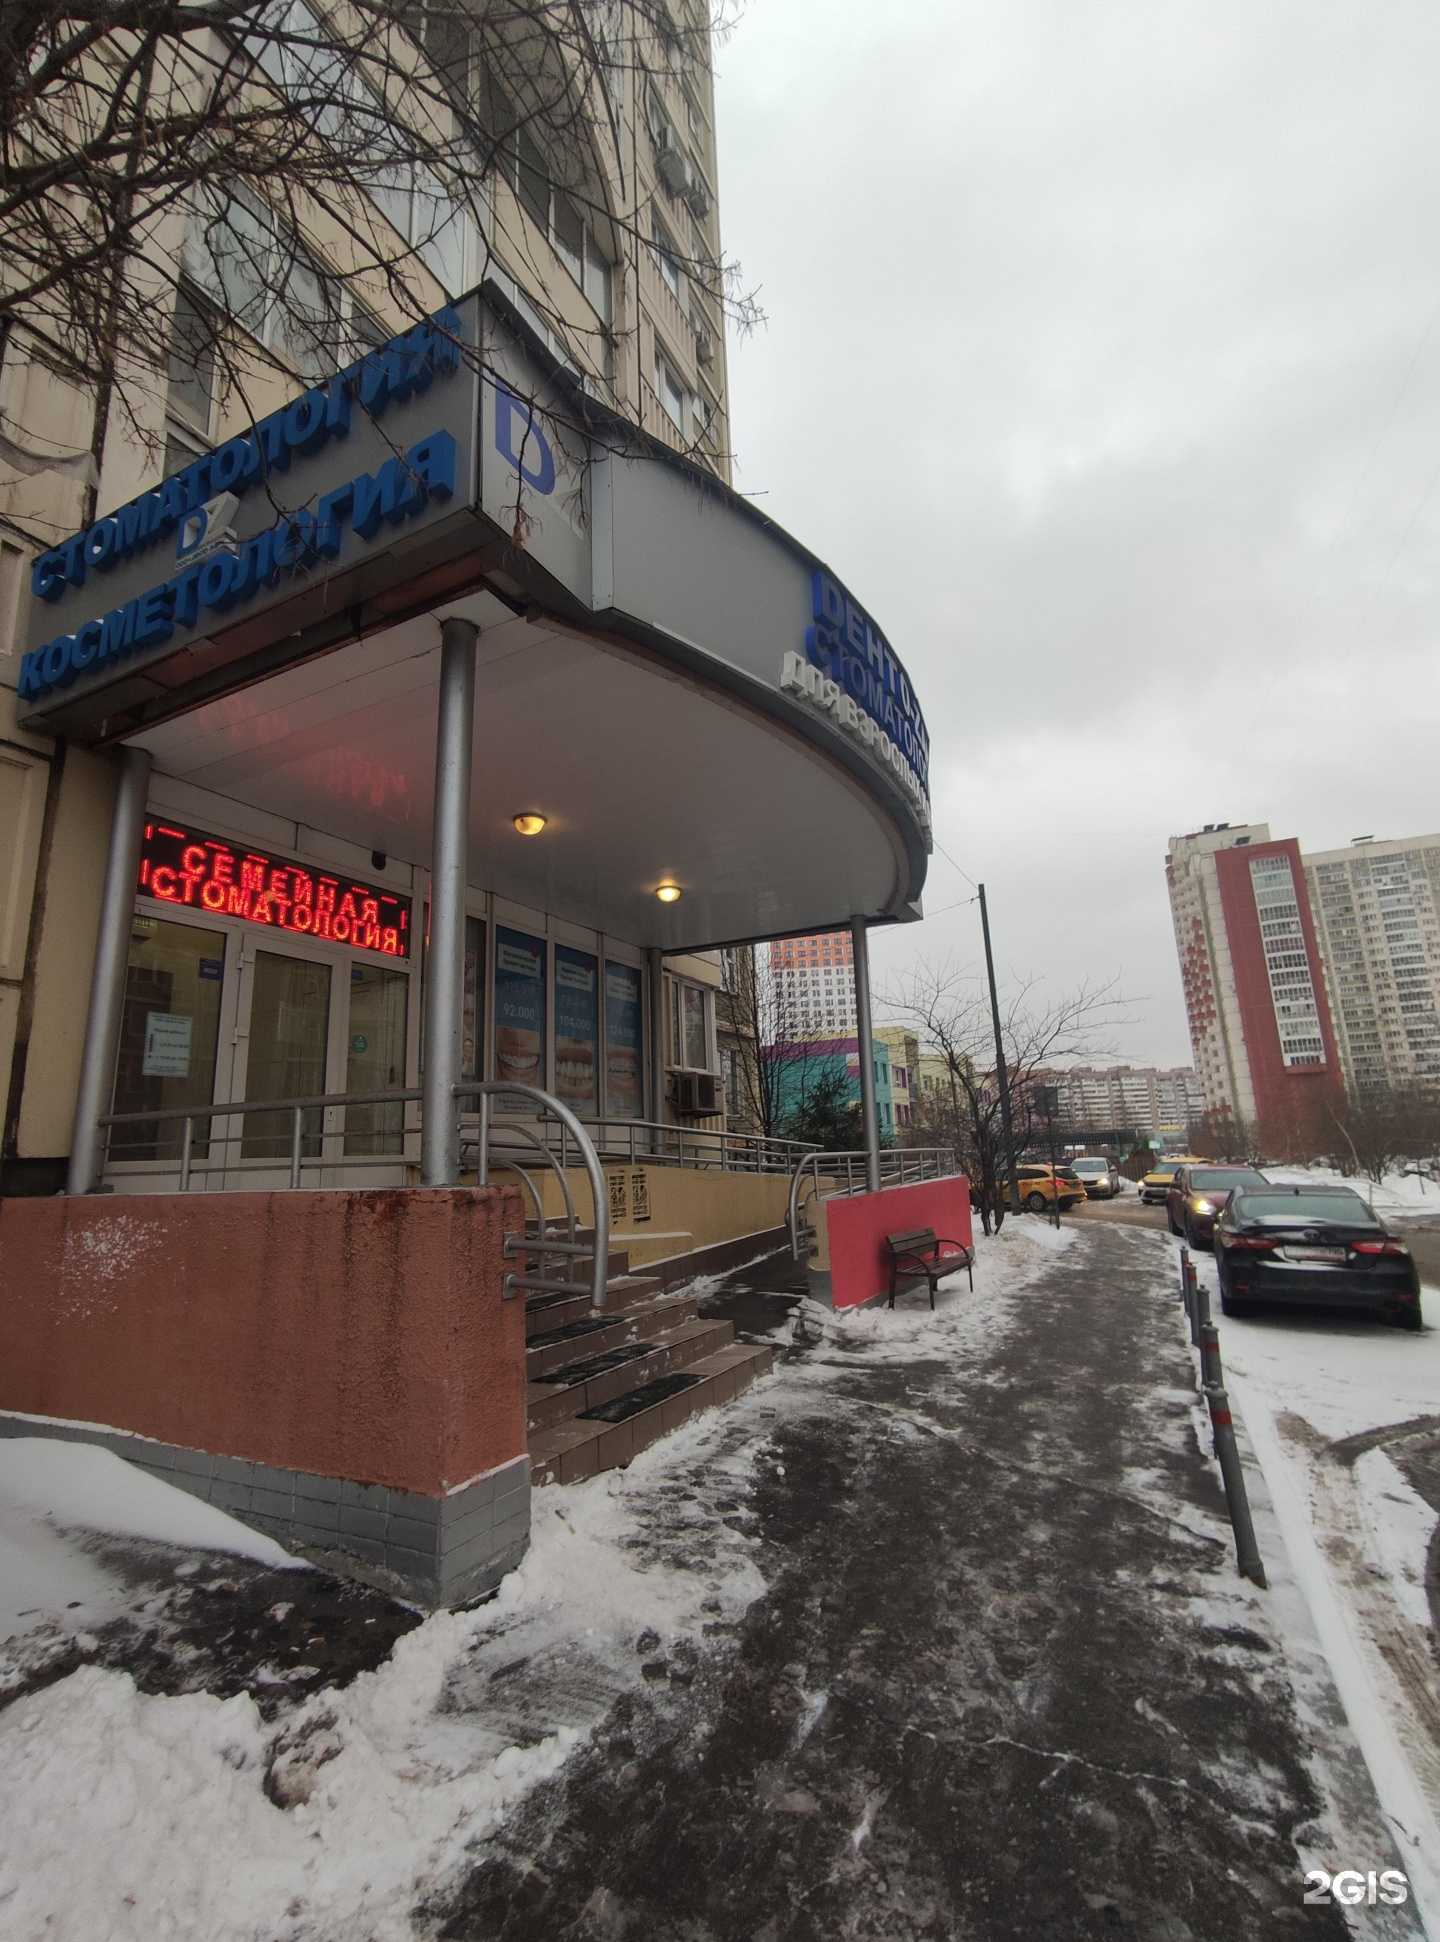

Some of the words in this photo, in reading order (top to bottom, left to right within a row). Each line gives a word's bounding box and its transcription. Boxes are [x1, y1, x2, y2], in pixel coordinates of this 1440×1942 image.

[31, 304, 461, 599] СТОМАТОЛОГИЯ
[17, 429, 456, 700] КОСМЕТОЛОГИЯ
[781, 650, 840, 707] ДЛЯ
[151, 866, 398, 954] СТОМАТОЛОГИЯ
[182, 845, 379, 924] СЕМЕЙНАЯ
